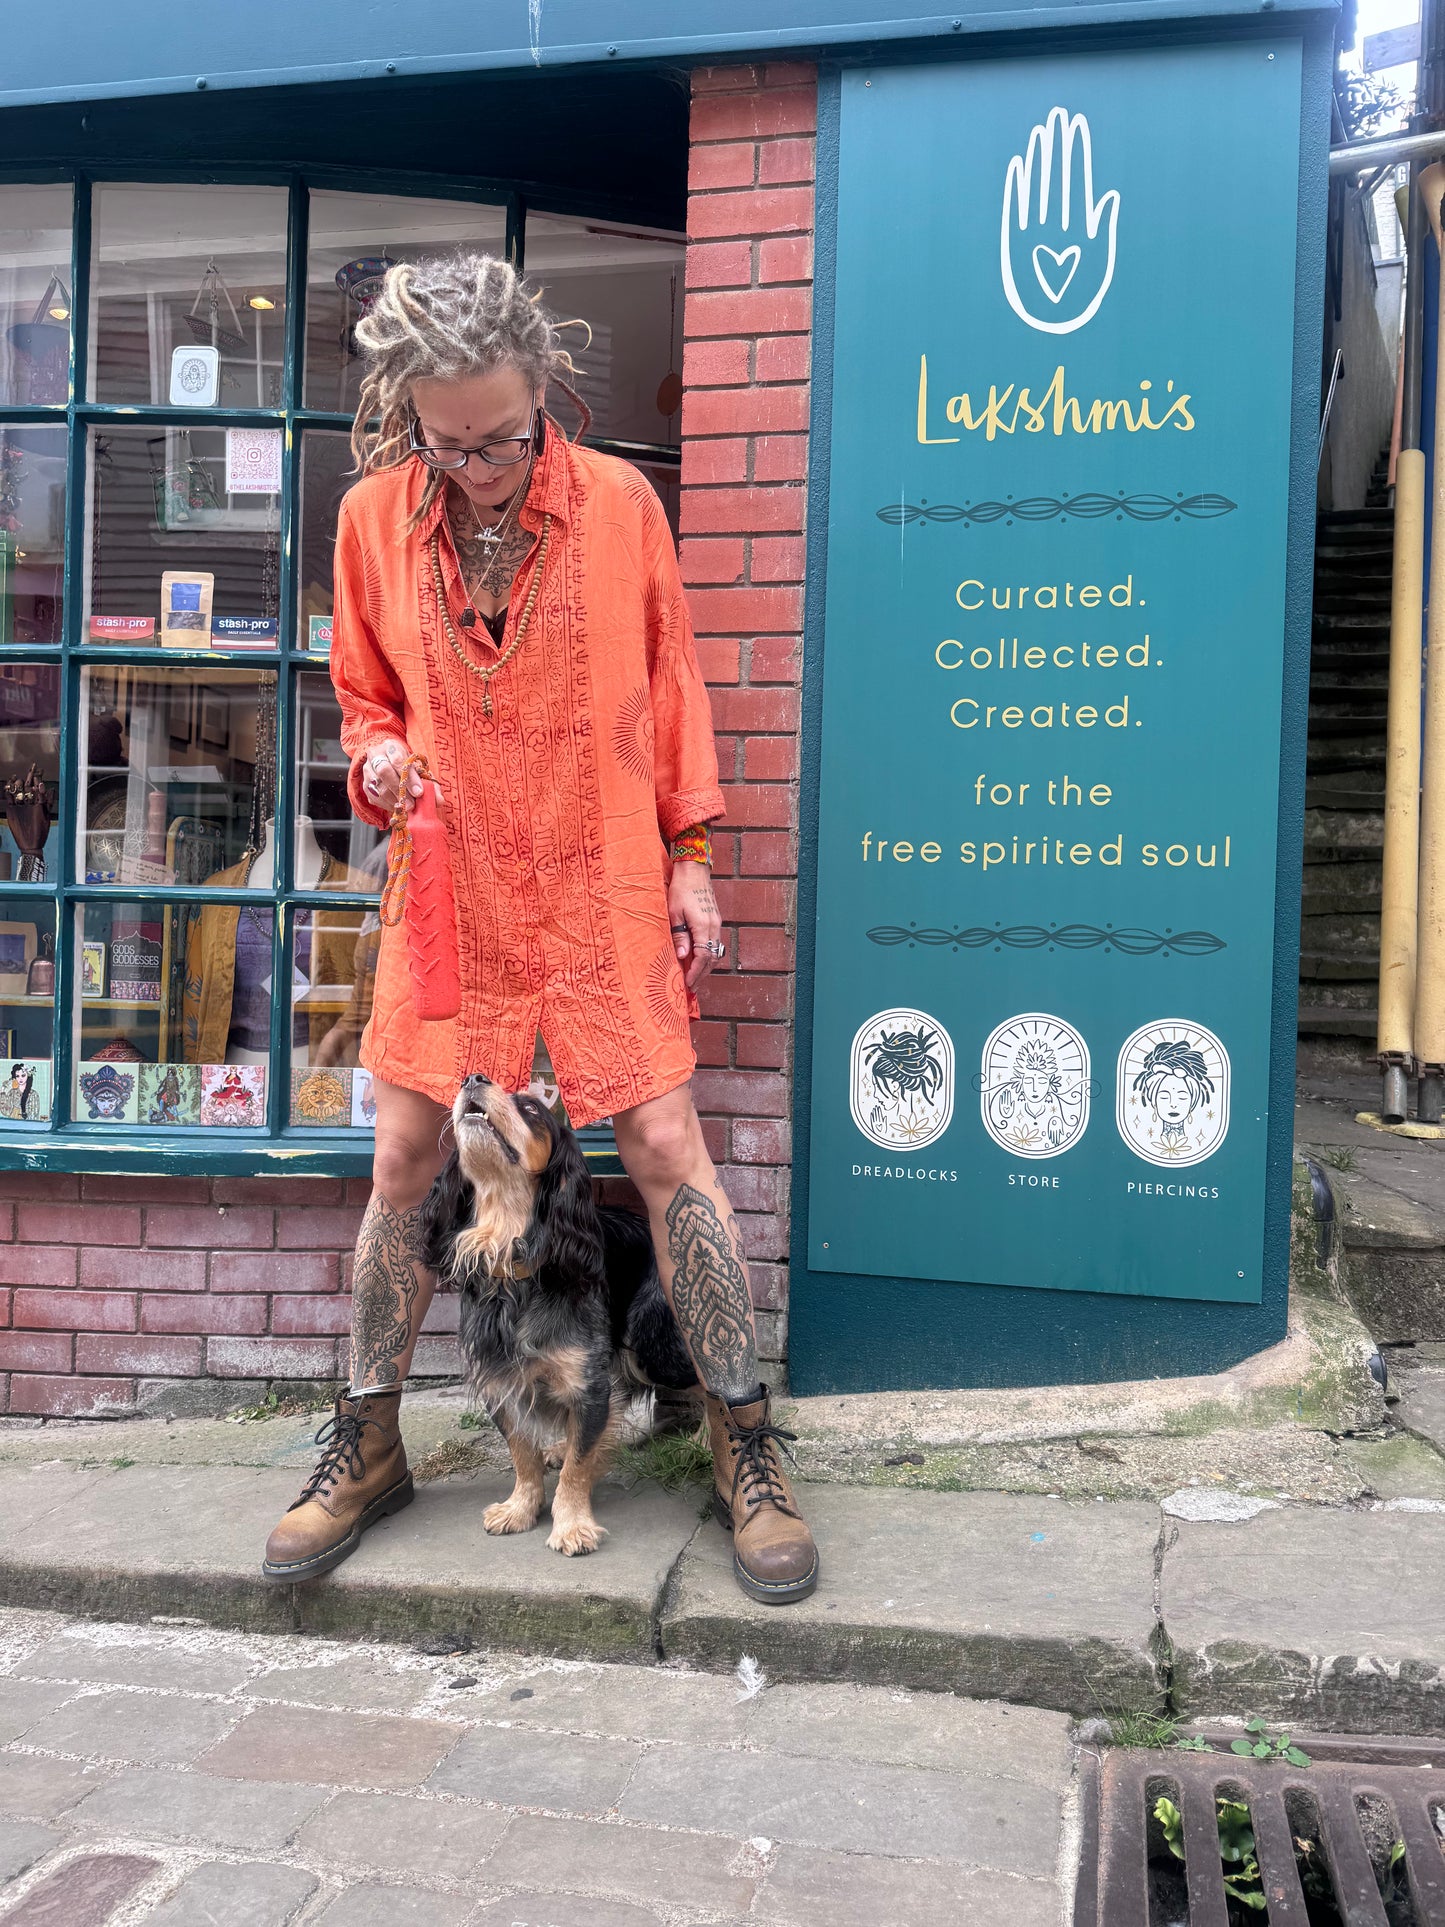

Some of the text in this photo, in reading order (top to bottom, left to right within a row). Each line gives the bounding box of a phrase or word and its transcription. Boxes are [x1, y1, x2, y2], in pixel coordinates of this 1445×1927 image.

[916, 354, 1196, 445] Lakshmi's
[955, 574, 1146, 610] Curated.
[96, 618, 147, 629] stash-pro
[218, 618, 270, 630] stash-pro
[935, 634, 1163, 669] Collected.
[950, 696, 1142, 728] Created.
[975, 775, 1112, 806] for the
[862, 832, 1231, 870] free spirited soul
[112, 944, 136, 955] GODS
[112, 954, 160, 966] GODDESSES
[852, 1164, 958, 1182] DREADLOCKS
[1007, 1174, 1060, 1188] STORE
[1126, 1182, 1220, 1199] PIERCINGS
